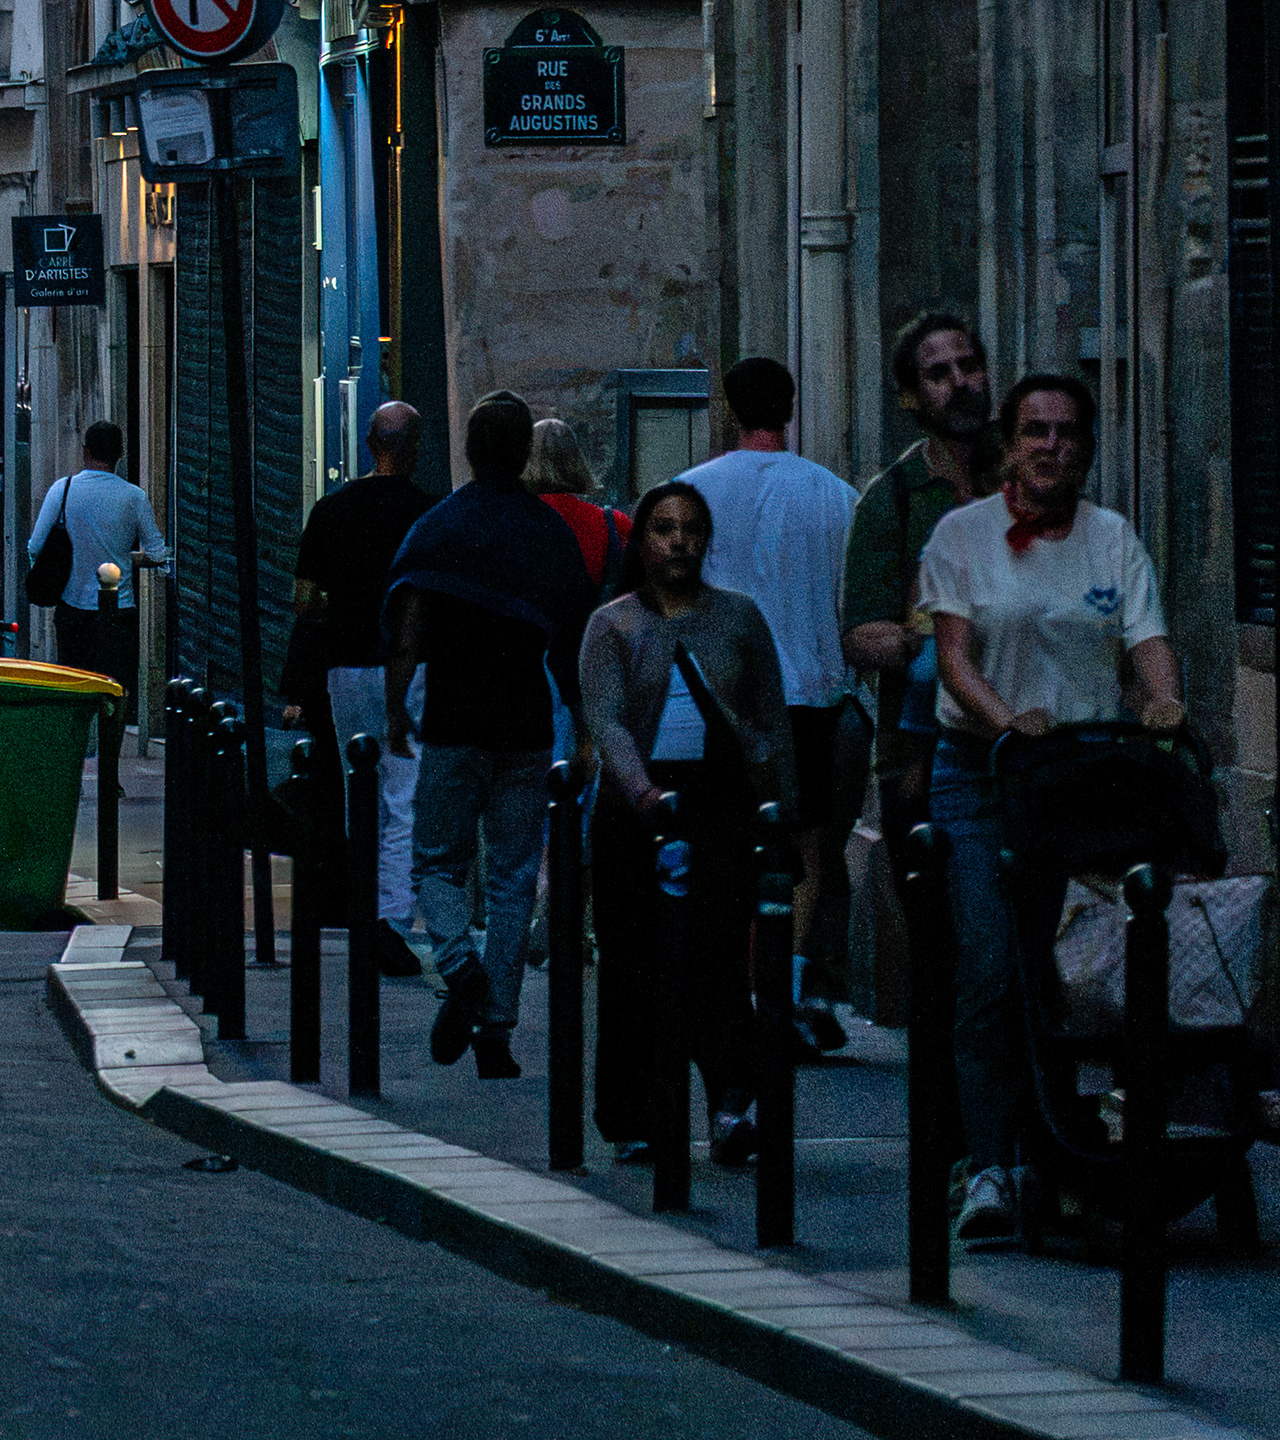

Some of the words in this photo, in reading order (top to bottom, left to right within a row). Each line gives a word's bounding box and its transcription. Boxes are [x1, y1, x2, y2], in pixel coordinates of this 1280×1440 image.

[537, 60, 568, 77] RUE
[544, 80, 561, 91] DES
[521, 94, 587, 111] GRANDS
[509, 115, 599, 131] AUGUSTINS
[30, 288, 65, 298] Galerie
